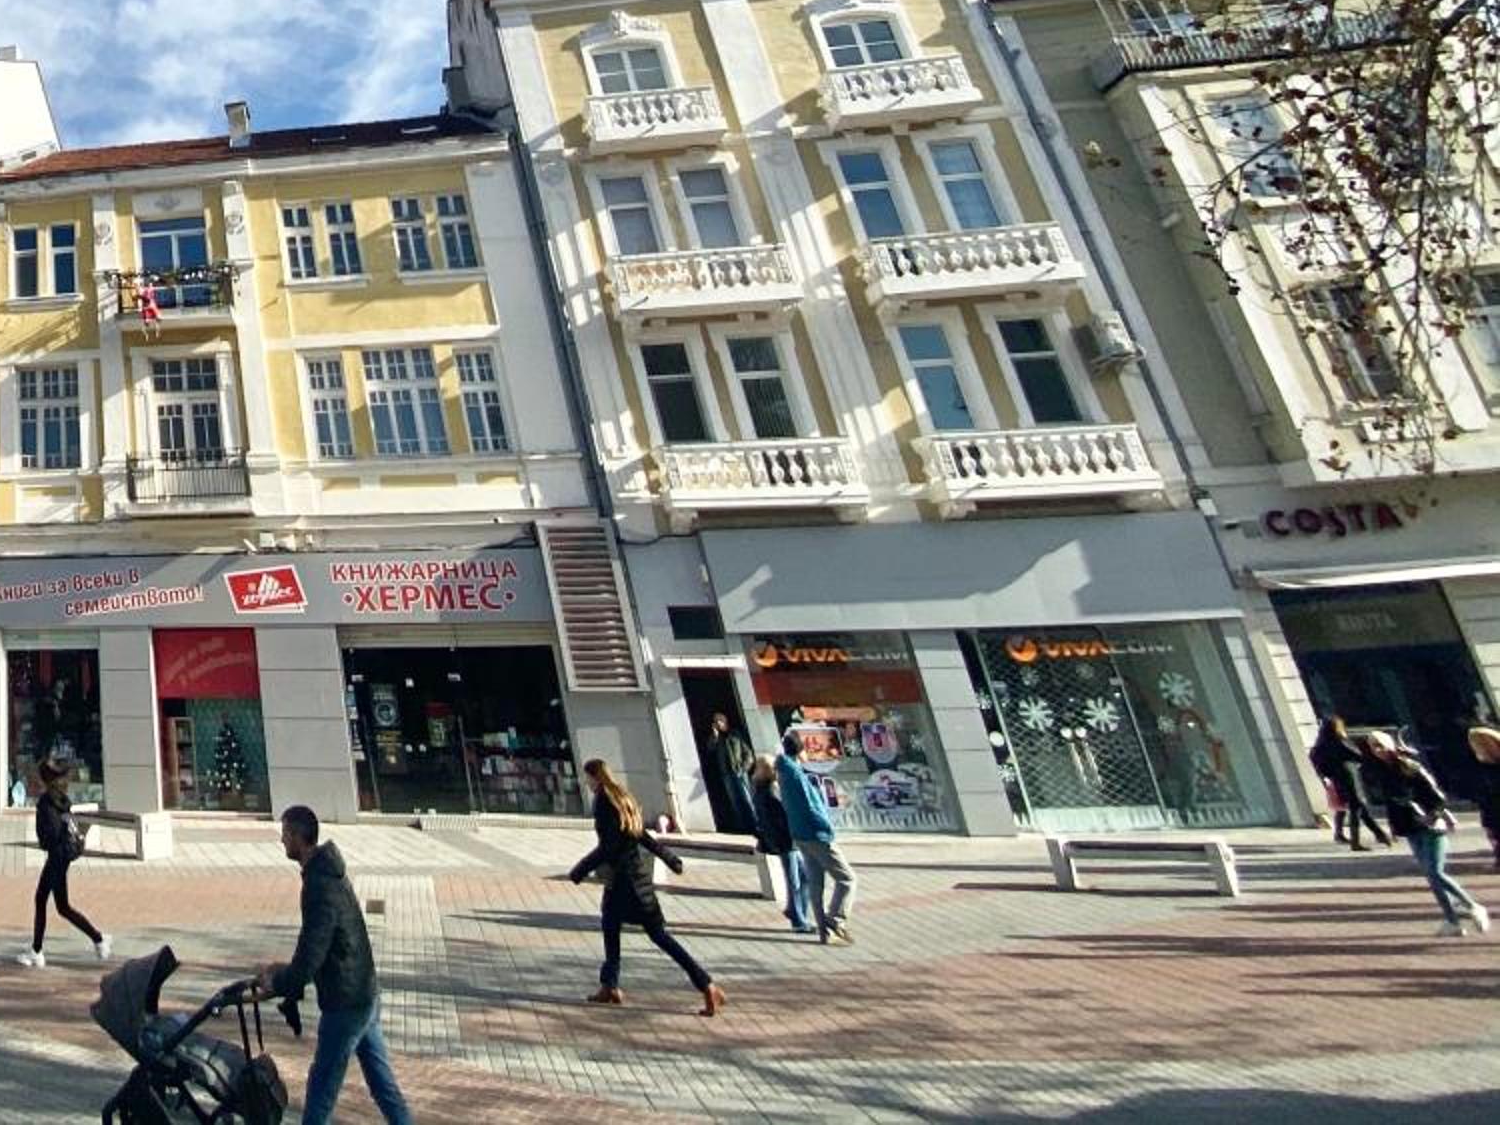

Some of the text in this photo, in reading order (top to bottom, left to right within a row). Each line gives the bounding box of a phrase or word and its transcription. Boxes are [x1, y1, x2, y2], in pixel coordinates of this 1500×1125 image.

[1264, 505, 1404, 537] COSTA
[331, 559, 518, 582] КНИЖАРНИЦА
[49, 579, 68, 594] за
[73, 571, 123, 592] всеки
